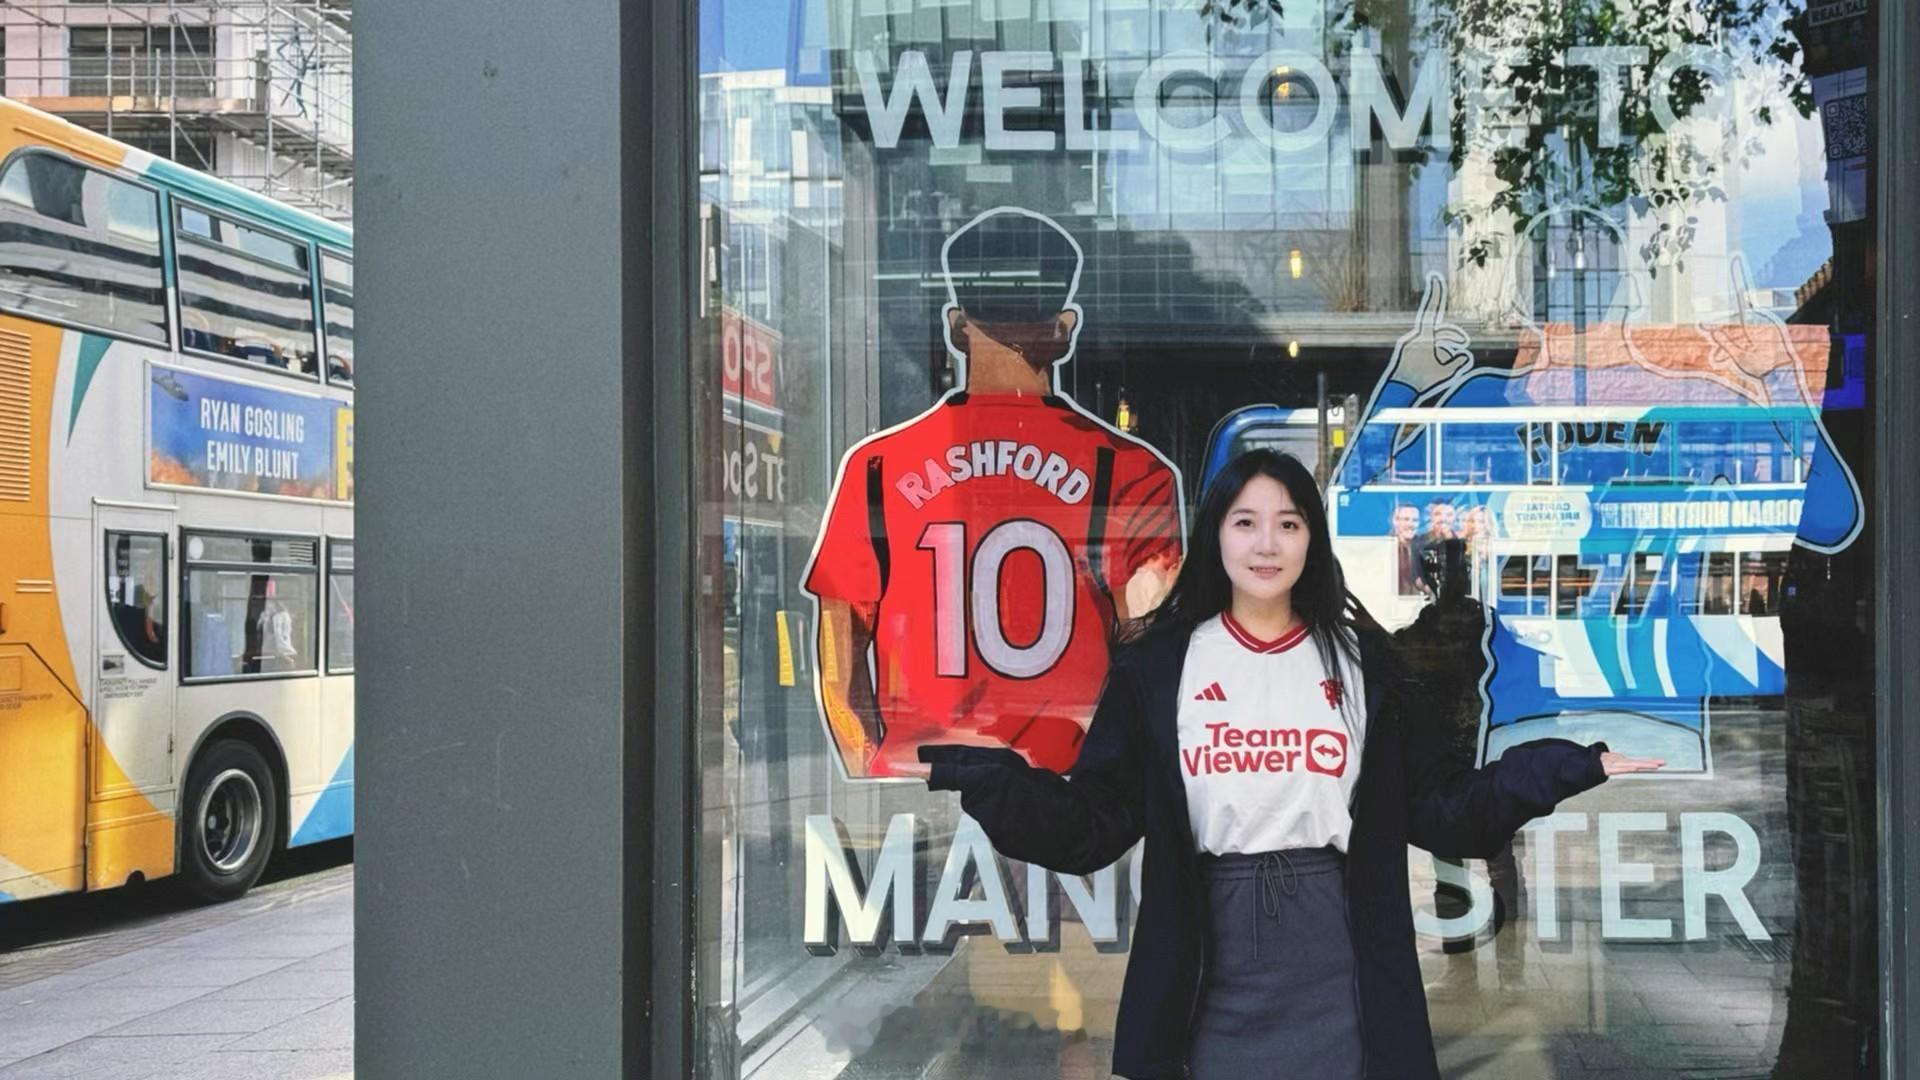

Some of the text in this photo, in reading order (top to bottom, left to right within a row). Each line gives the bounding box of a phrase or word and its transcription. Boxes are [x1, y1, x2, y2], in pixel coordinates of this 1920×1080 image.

[856, 46, 1736, 151] WELCOME TO
[200, 397, 304, 443] RYAN GOSLING
[207, 440, 299, 481] EMILY BLUNT
[1515, 421, 1666, 466] FODEN
[896, 440, 1091, 510] RASHFORD
[916, 517, 1076, 680] 10
[1205, 722, 1301, 748] Team
[1182, 745, 1301, 777] Viewer
